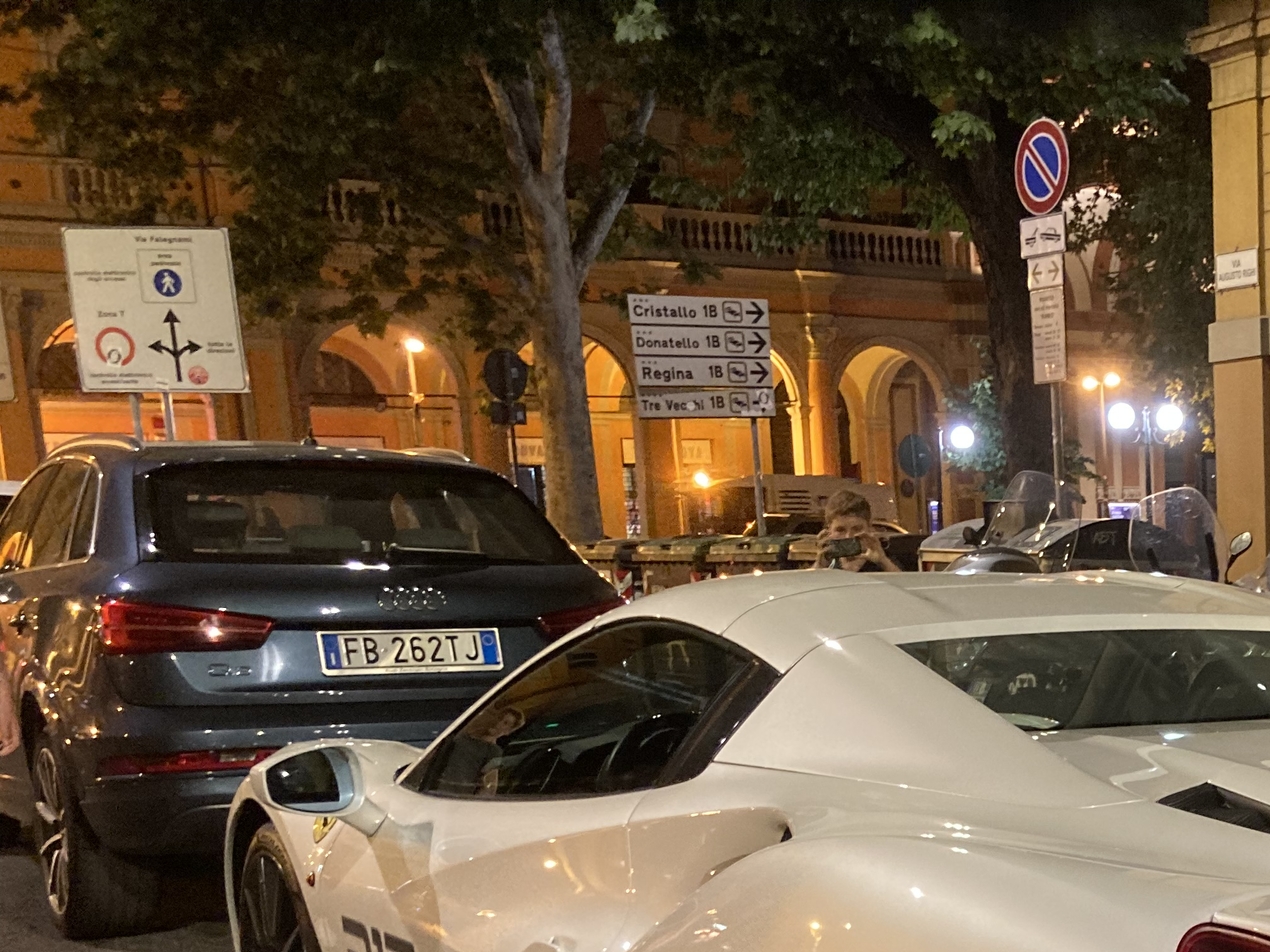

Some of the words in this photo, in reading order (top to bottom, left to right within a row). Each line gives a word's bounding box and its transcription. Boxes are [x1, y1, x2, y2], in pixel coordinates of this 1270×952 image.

[1231, 259, 1241, 268] VIA
[633, 304, 696, 319] Cristallo
[702, 305, 718, 318] 1B
[636, 336, 700, 349] Donatello
[706, 336, 720, 348] 1B
[642, 366, 694, 382] Regina
[709, 366, 723, 378] 1B
[641, 399, 661, 411] Tre
[666, 399, 704, 411] Vechi
[710, 396, 725, 409] 1B
[343, 637, 380, 666] FB
[391, 635, 479, 664] 262TJ
